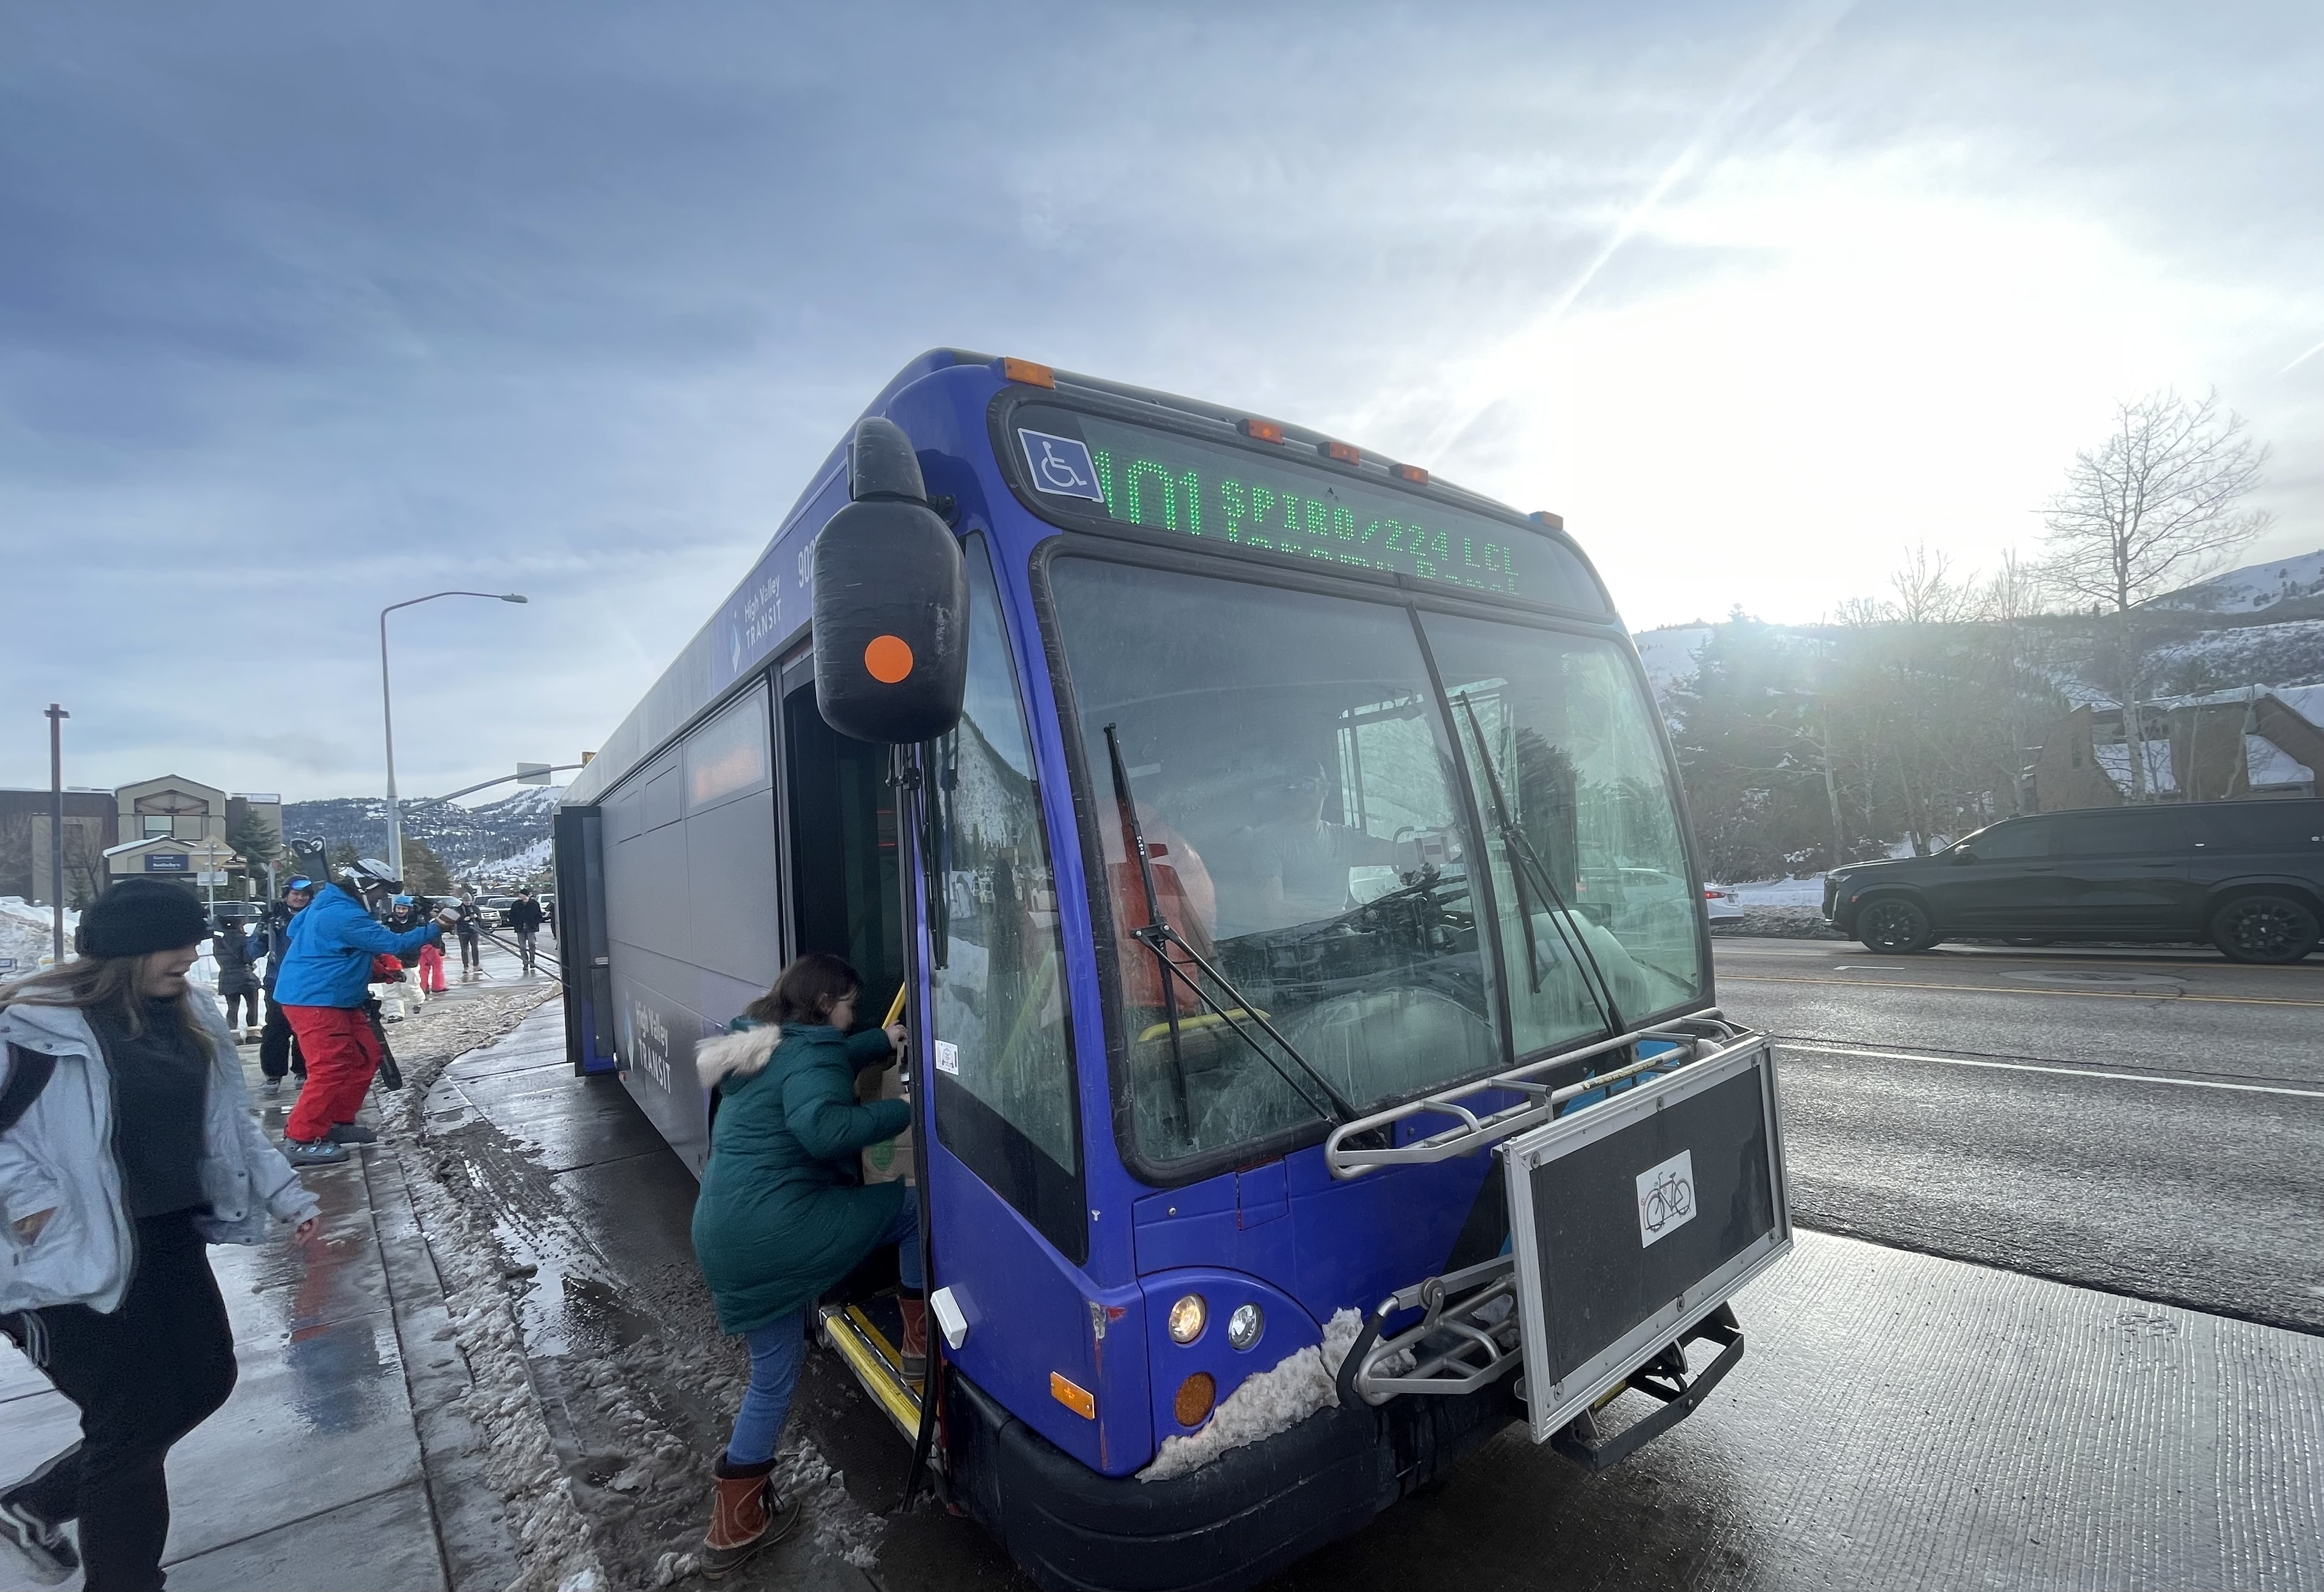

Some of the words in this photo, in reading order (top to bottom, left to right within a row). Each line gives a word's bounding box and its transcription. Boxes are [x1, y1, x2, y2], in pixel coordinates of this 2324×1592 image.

[1221, 480, 1448, 560] SPIRO/224
[1465, 537, 1518, 576] LCL
[798, 532, 820, 588] 902
[744, 594, 759, 622] High
[759, 574, 780, 605] Valley
[746, 599, 781, 649] TRANSIT
[635, 1000, 649, 1038] High
[648, 1007, 668, 1057] Valley
[638, 1038, 671, 1094] TRANSIT
